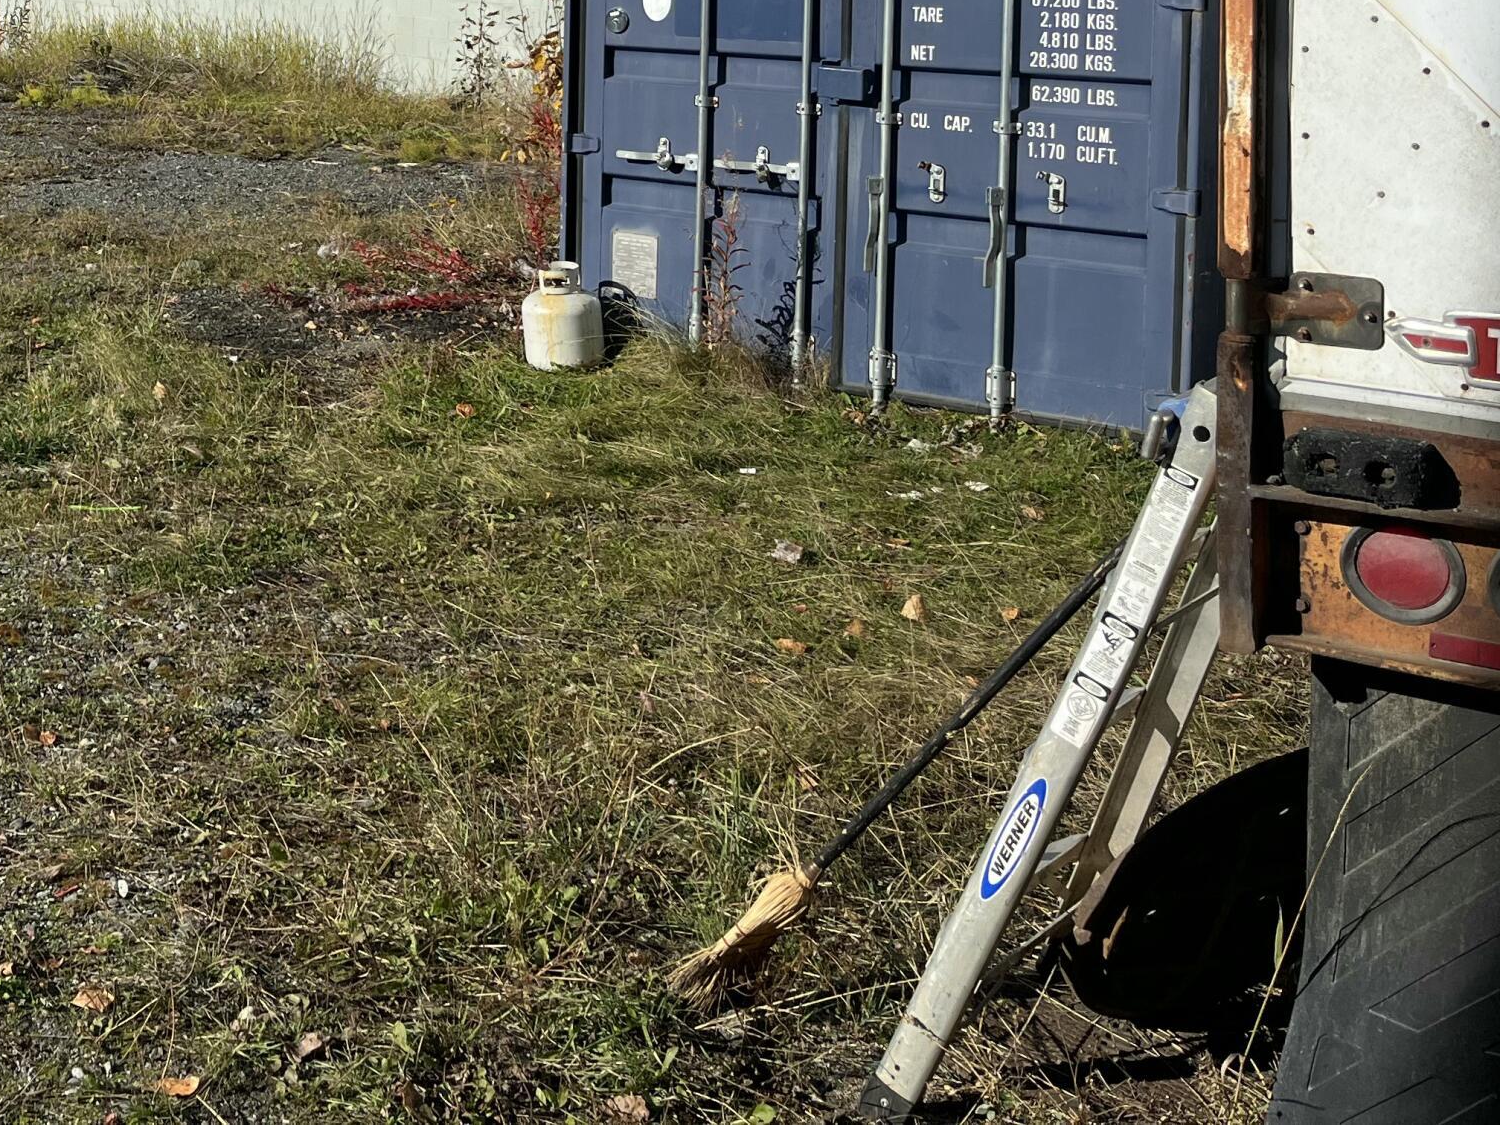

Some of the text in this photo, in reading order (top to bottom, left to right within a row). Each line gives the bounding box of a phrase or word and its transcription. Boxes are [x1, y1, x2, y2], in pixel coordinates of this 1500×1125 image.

[912, 6, 944, 23] TARE
[1086, 13, 1118, 31] KGS.
[1086, 33, 1117, 51] LBS.
[910, 44, 935, 61] NET
[1085, 54, 1117, 72] KGS.
[1087, 89, 1118, 107] LBS.
[910, 112, 973, 133] CU. CAP.
[1026, 122, 1113, 144] 33.1 CU.M.
[1076, 146, 1118, 165] CU.FT.
[990, 799, 1037, 877] WERNER
